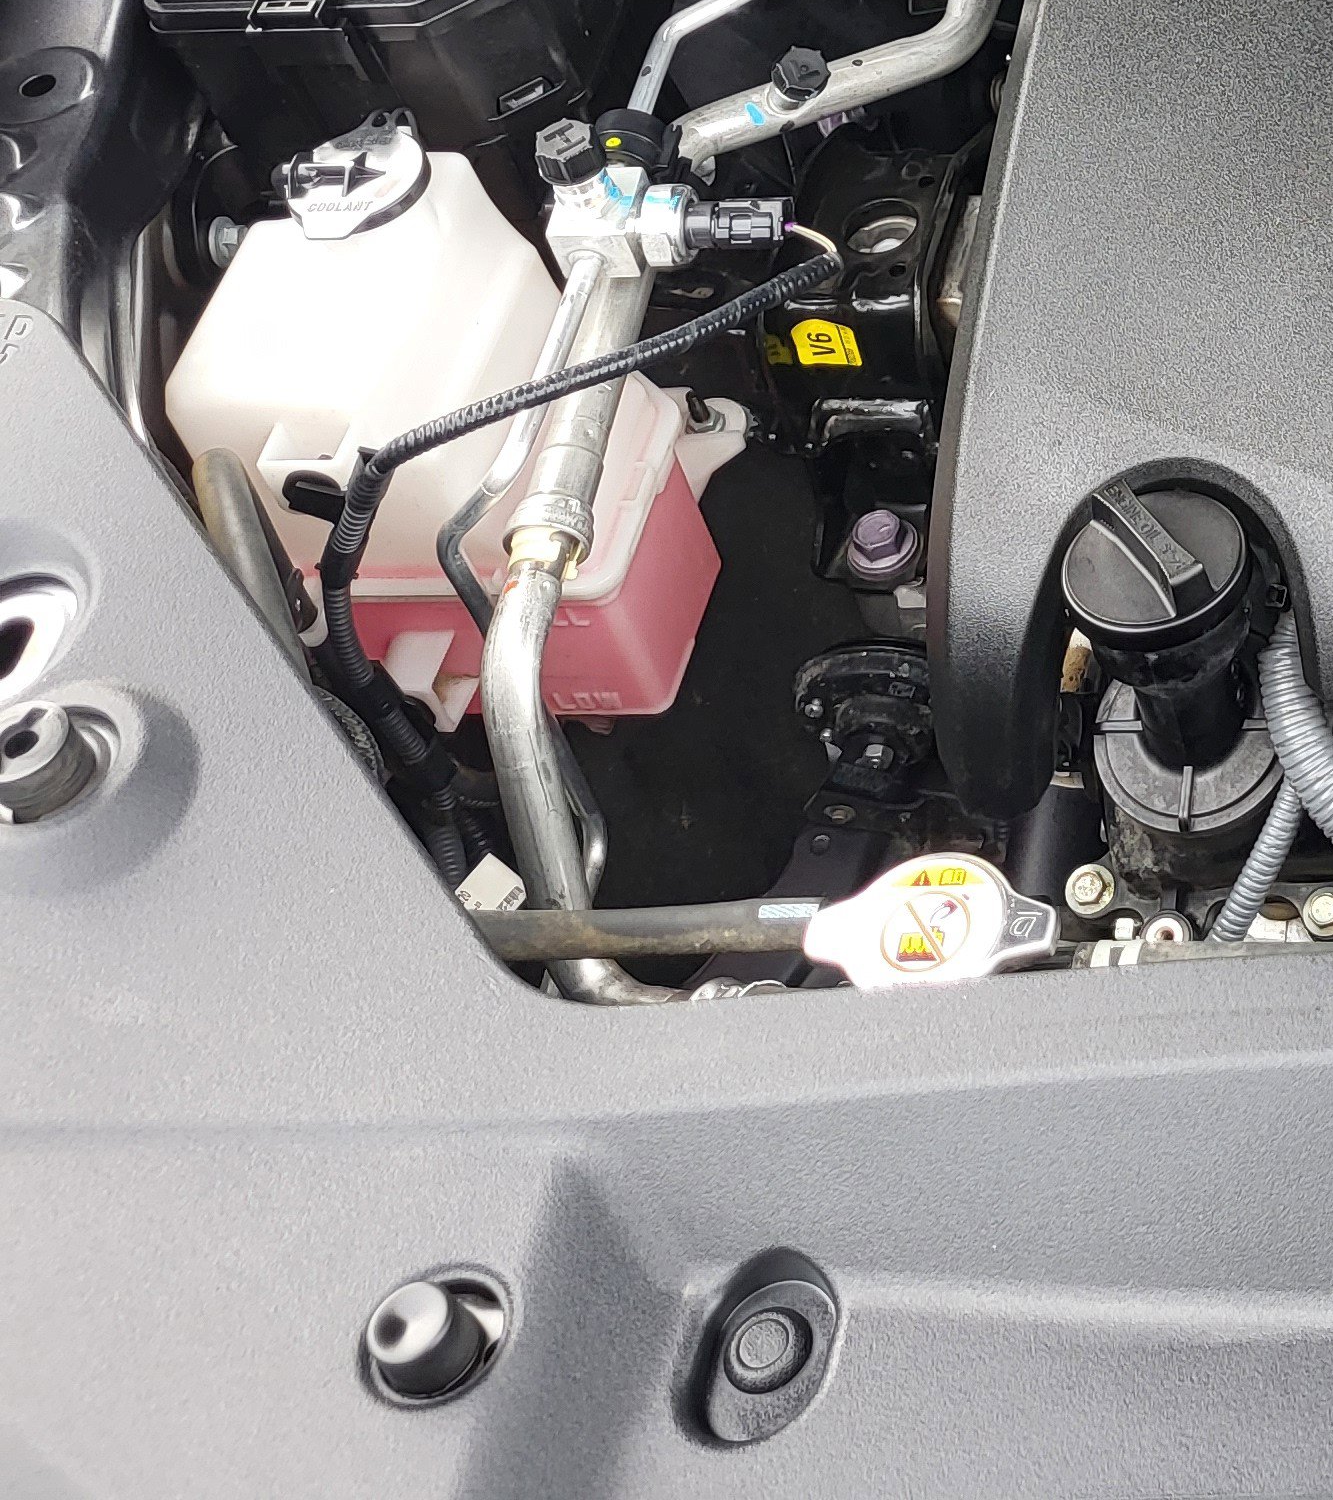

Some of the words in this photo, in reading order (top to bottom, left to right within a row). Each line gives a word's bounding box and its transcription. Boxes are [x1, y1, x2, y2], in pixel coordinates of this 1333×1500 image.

[307, 200, 373, 213] COOLANT
[806, 332, 837, 356] V6
[1103, 483, 1143, 526] ENGINE
[1140, 521, 1163, 543] OIL
[551, 691, 623, 710] LOW
